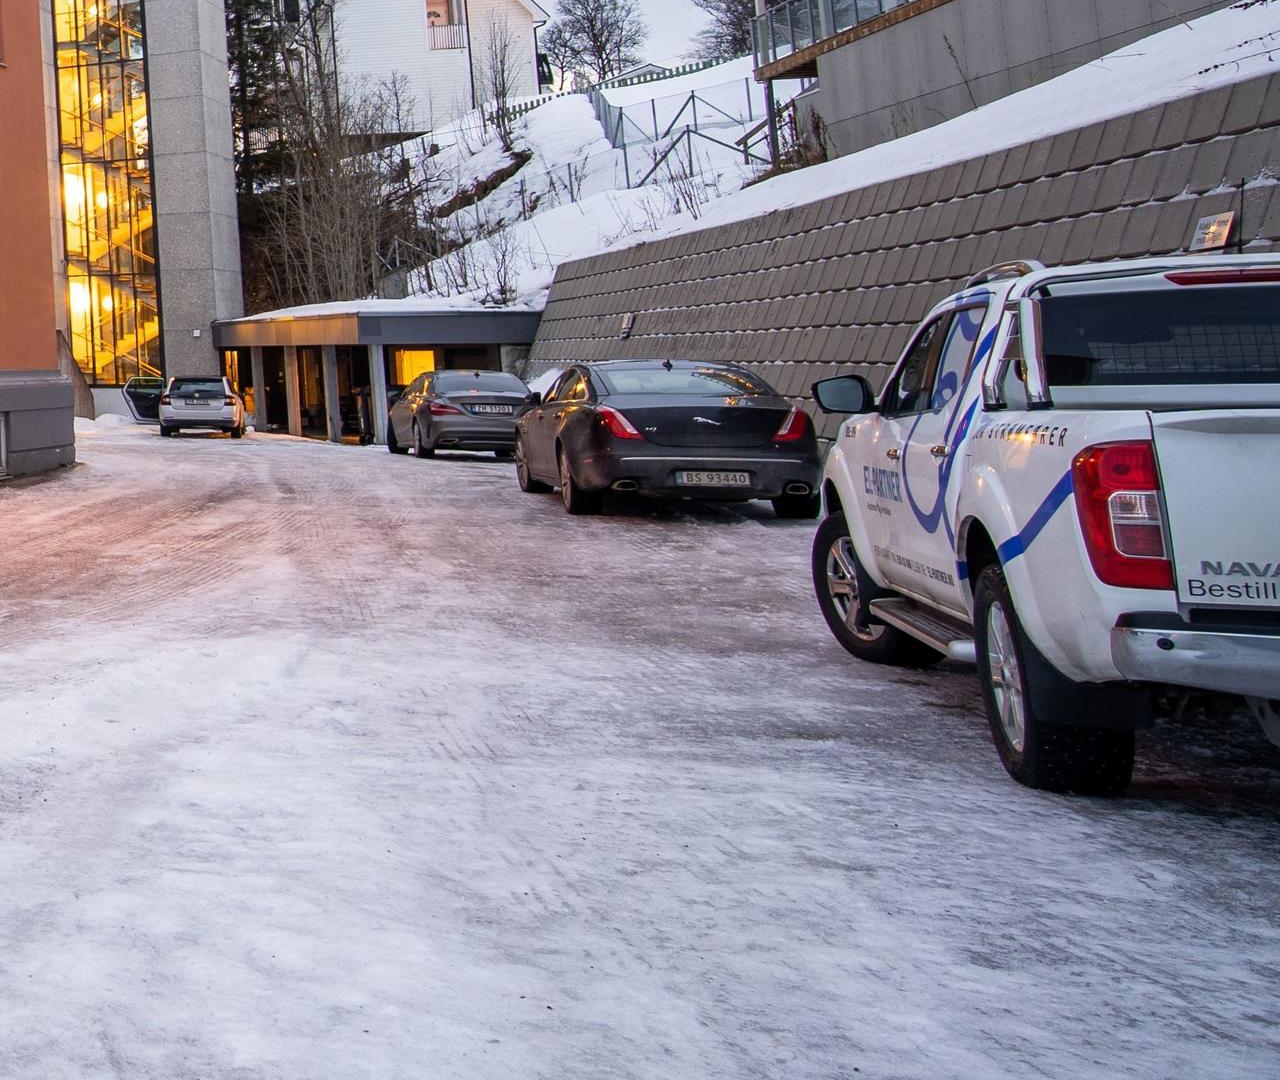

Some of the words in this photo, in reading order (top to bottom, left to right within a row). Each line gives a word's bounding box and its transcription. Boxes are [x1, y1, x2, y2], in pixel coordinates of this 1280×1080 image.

[686, 473, 702, 483] BS
[706, 473, 746, 484] 93440
[1188, 579, 1277, 600] Bestill
